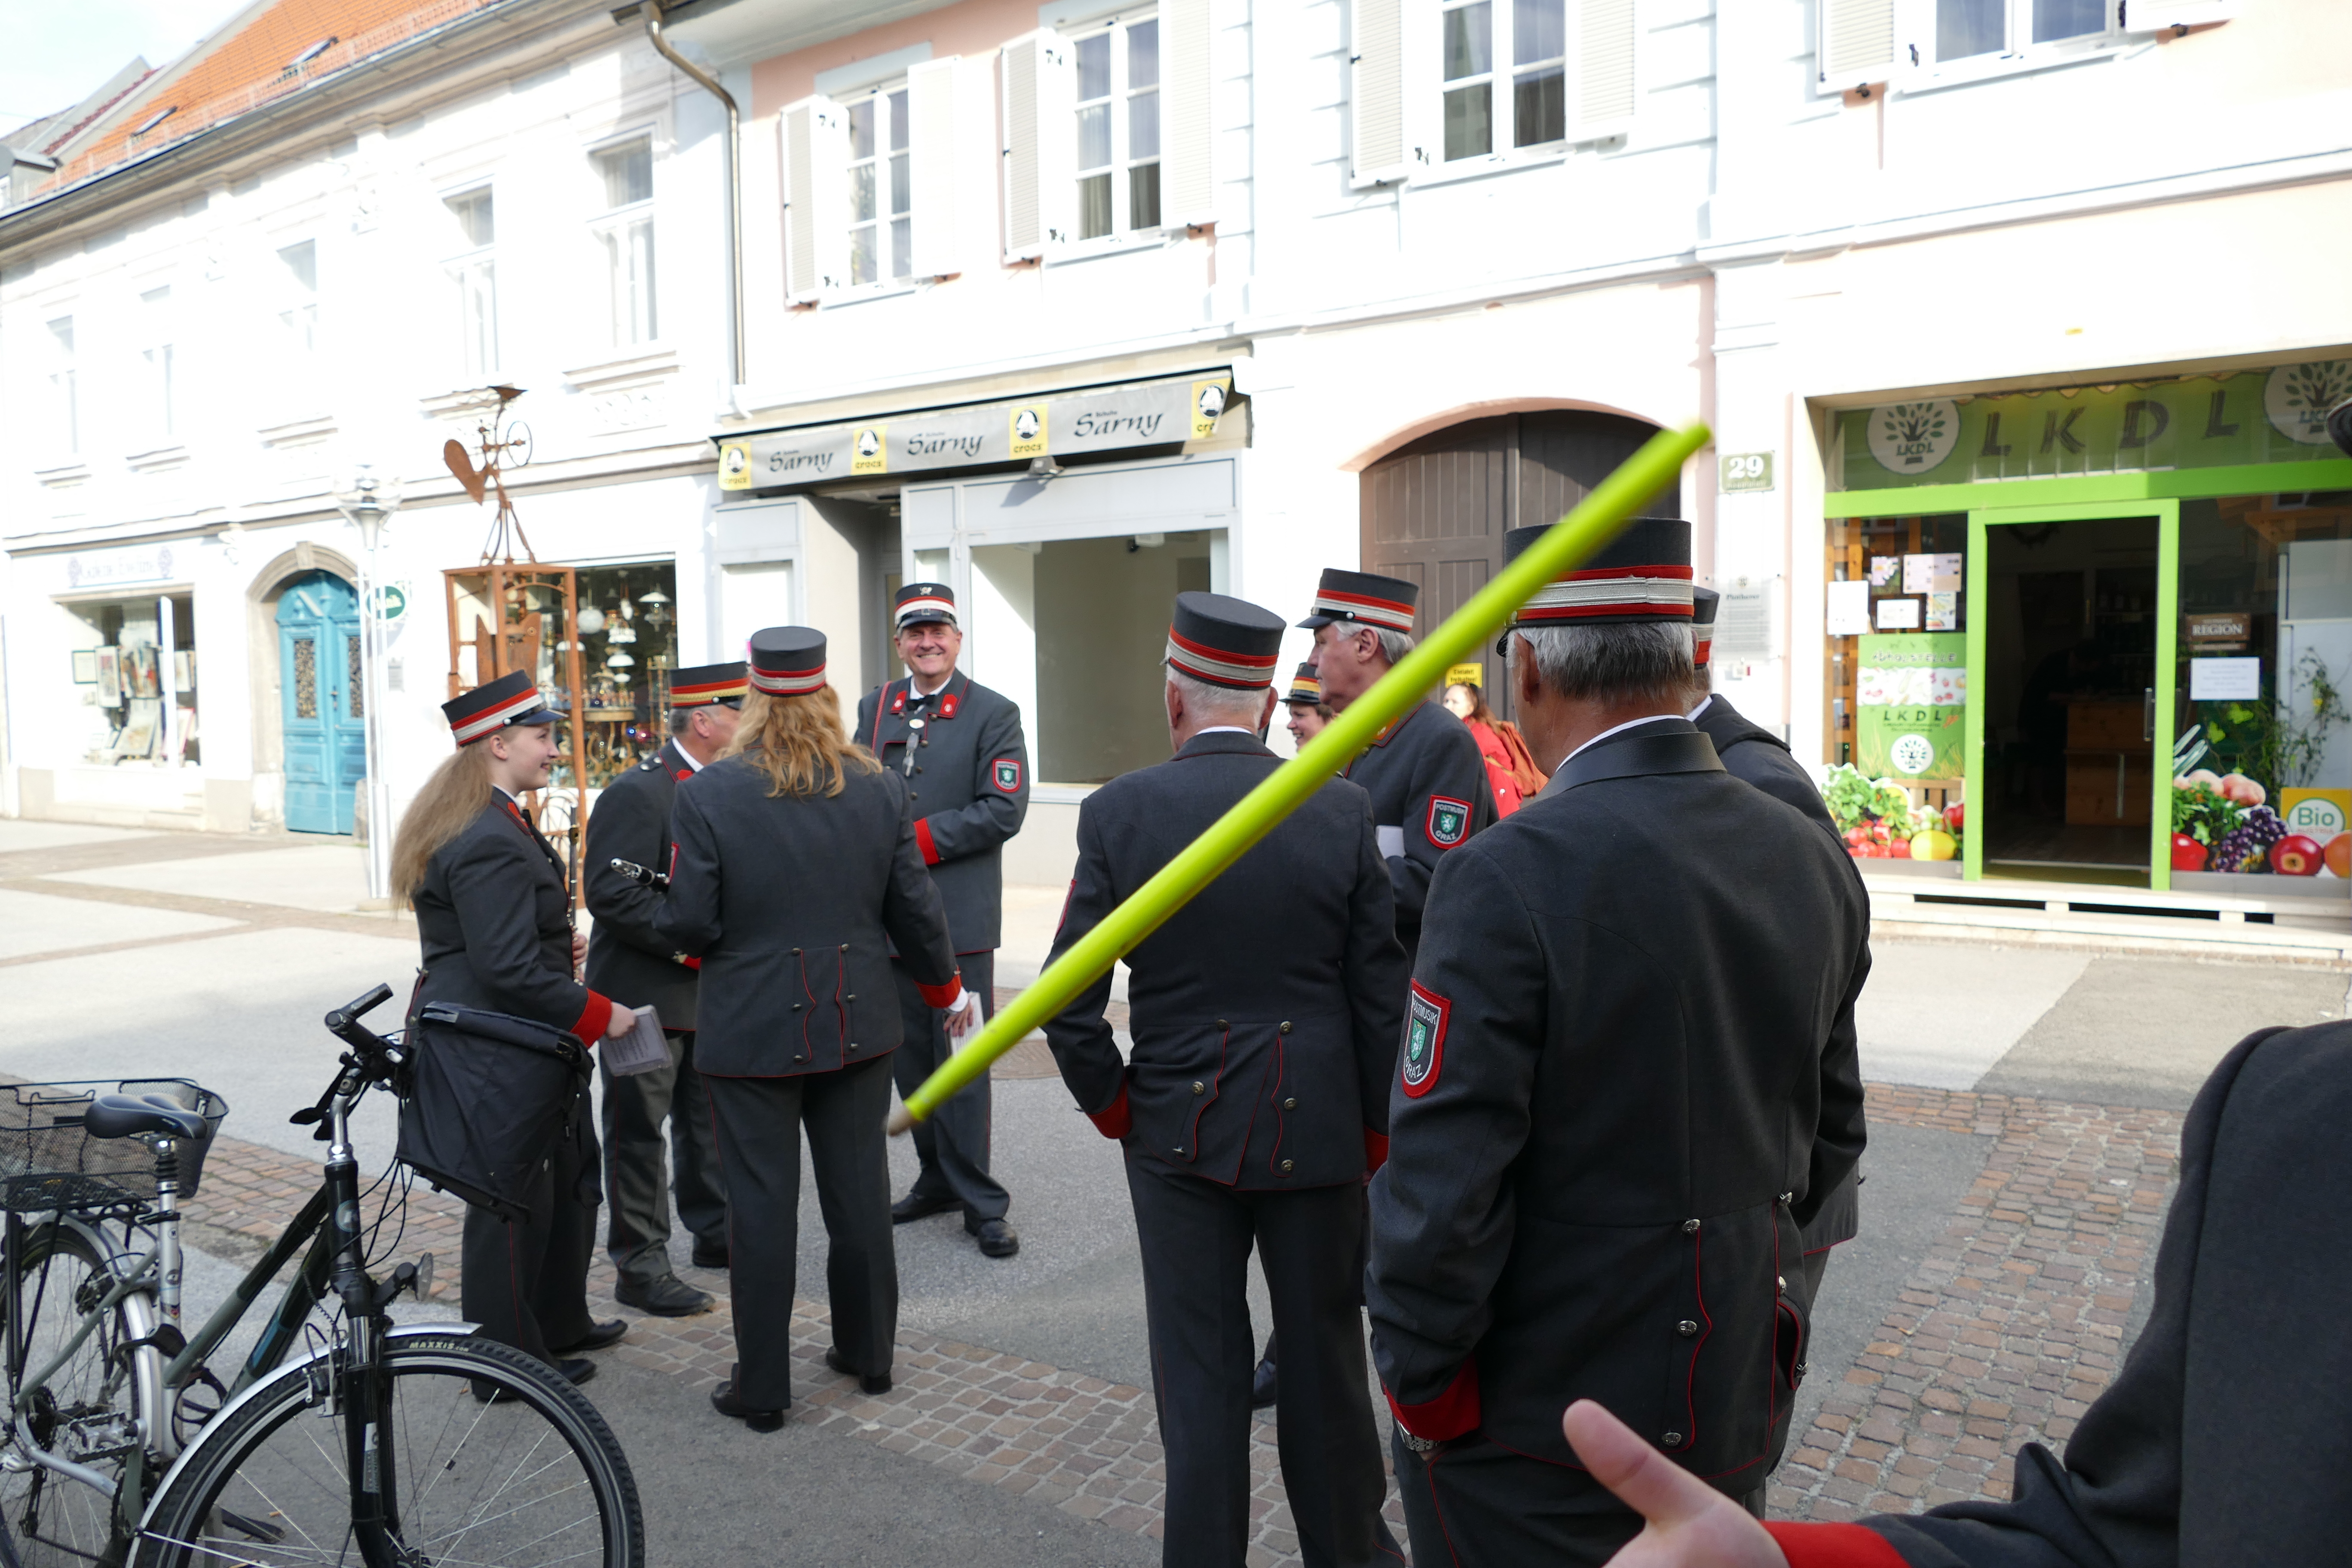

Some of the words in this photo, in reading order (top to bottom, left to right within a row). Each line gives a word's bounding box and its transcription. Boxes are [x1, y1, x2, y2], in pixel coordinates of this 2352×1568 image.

[1074, 413, 1164, 438] Sarny
[907, 432, 984, 457] Sarny
[1014, 444, 1041, 453] crocs
[1896, 441, 1935, 456] LKDL
[769, 451, 834, 472] Sarny
[854, 461, 882, 469] crocs
[1728, 455, 1764, 479] 29
[2192, 624, 2243, 635] REGION
[2298, 807, 2335, 826] Bio
[1435, 830, 1457, 841] GRAZ
[1412, 999, 1437, 1025] POSTMUSIK
[1405, 1056, 1423, 1078] GRAZ
